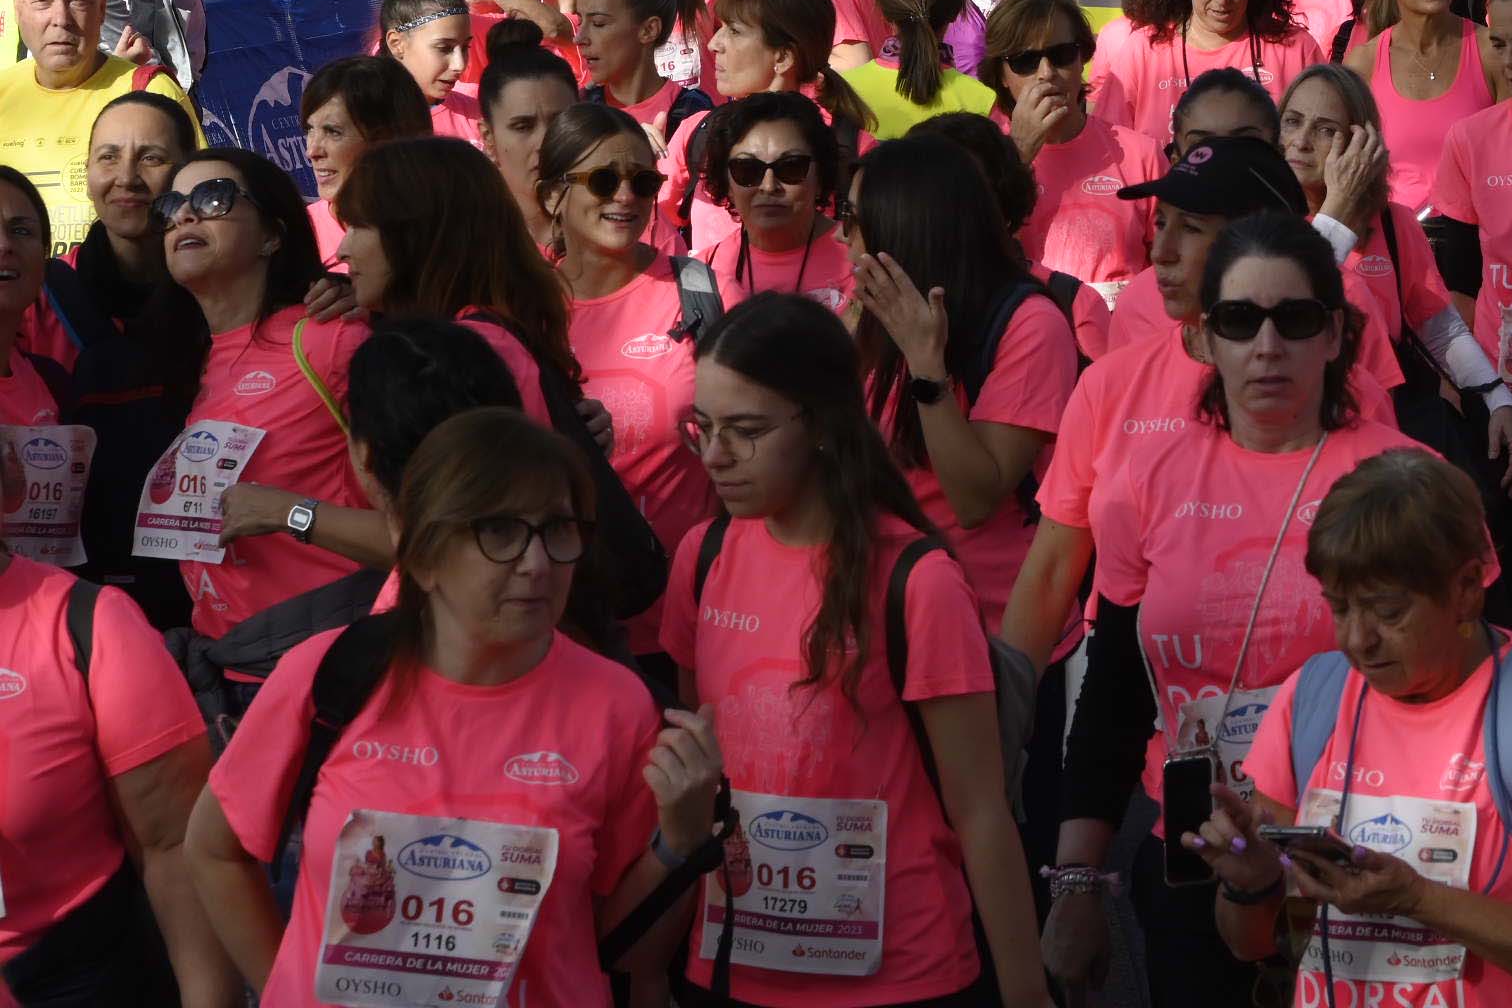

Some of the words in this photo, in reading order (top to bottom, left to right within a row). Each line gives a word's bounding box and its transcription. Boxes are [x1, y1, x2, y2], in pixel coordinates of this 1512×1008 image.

[1123, 417, 1186, 435] OYSHO
[28, 481, 63, 501] 016
[179, 474, 207, 495] 016
[141, 535, 178, 549] OYSHO
[1151, 633, 1202, 670] TU
[352, 739, 440, 767] OYSHO
[753, 822, 824, 844] ASTURIANA
[836, 822, 873, 834] SUMA
[1420, 823, 1460, 837] SUMA
[404, 851, 485, 873] ASTURIANA
[501, 851, 543, 866] SUMA
[756, 862, 817, 892] 016
[401, 894, 475, 927] 016
[762, 895, 808, 915] 17279
[767, 918, 777, 930] DE
[779, 920, 793, 932] LA
[795, 922, 833, 935] MUJER
[1355, 926, 1372, 937] DE
[1374, 928, 1389, 938] LA
[410, 931, 457, 952] 1116
[343, 950, 404, 968] CARRERA
[406, 957, 423, 970] DE
[425, 959, 443, 971] LA
[446, 961, 490, 976] MUJER
[807, 946, 867, 961] Santander
[1403, 953, 1463, 970] Santander
[335, 975, 402, 999] OYSHO
